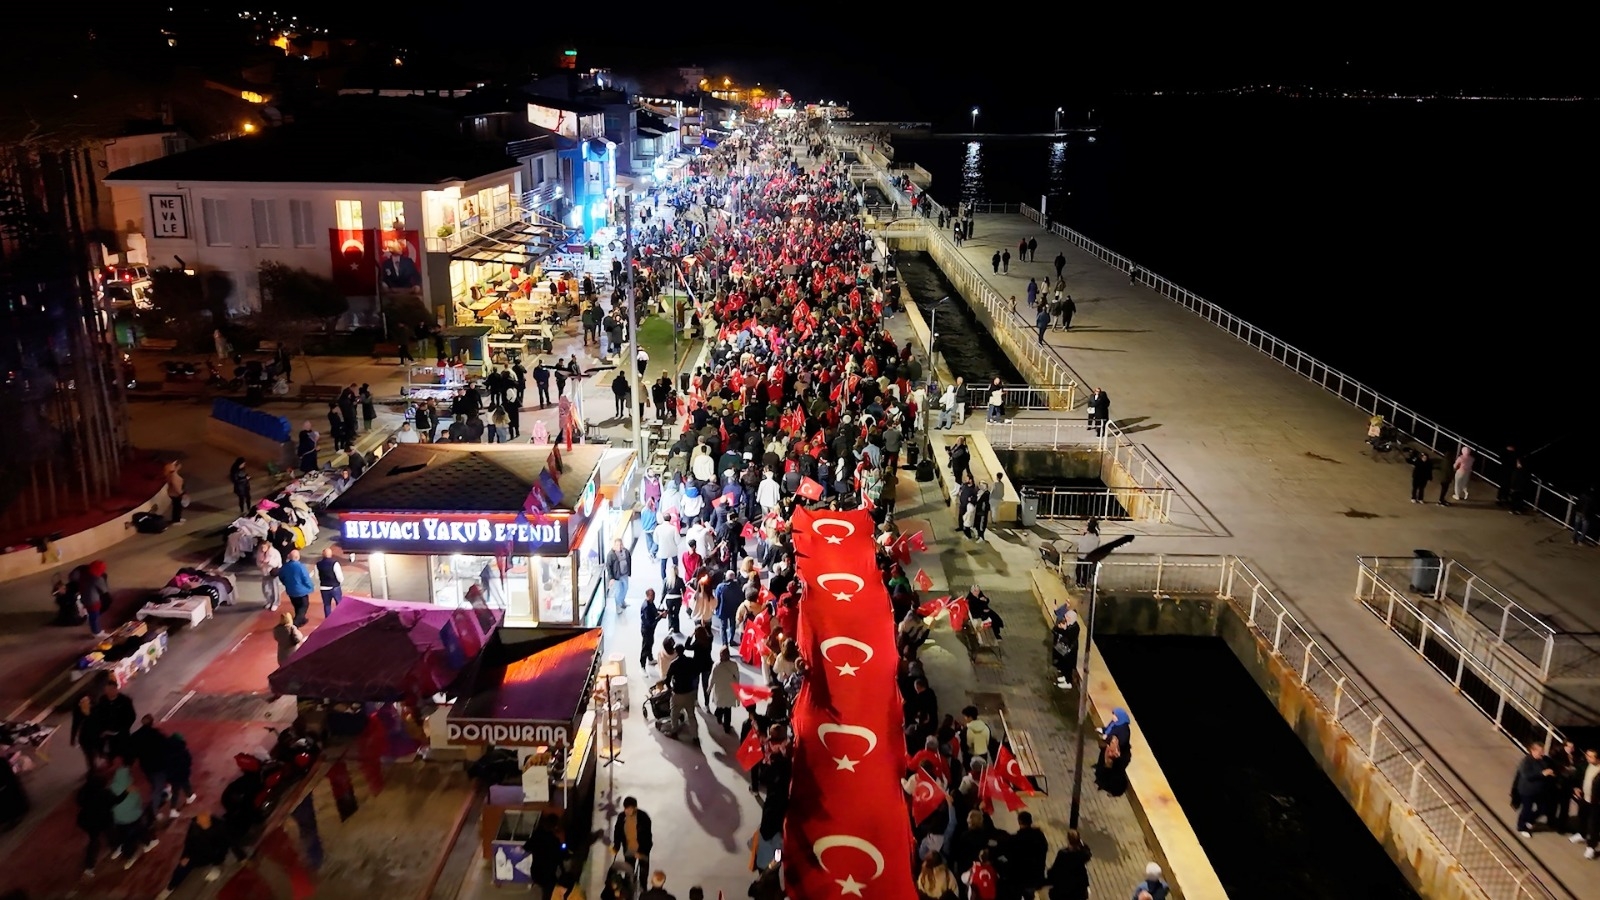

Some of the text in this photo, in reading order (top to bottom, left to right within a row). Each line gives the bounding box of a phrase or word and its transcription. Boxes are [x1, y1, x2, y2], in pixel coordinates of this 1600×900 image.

[160, 199, 175, 209] NE
[162, 212, 177, 221] VA
[163, 223, 177, 233] LE
[344, 520, 421, 540] HELVACI
[423, 518, 492, 543] YAKUB
[447, 723, 571, 747] DONDURMA
